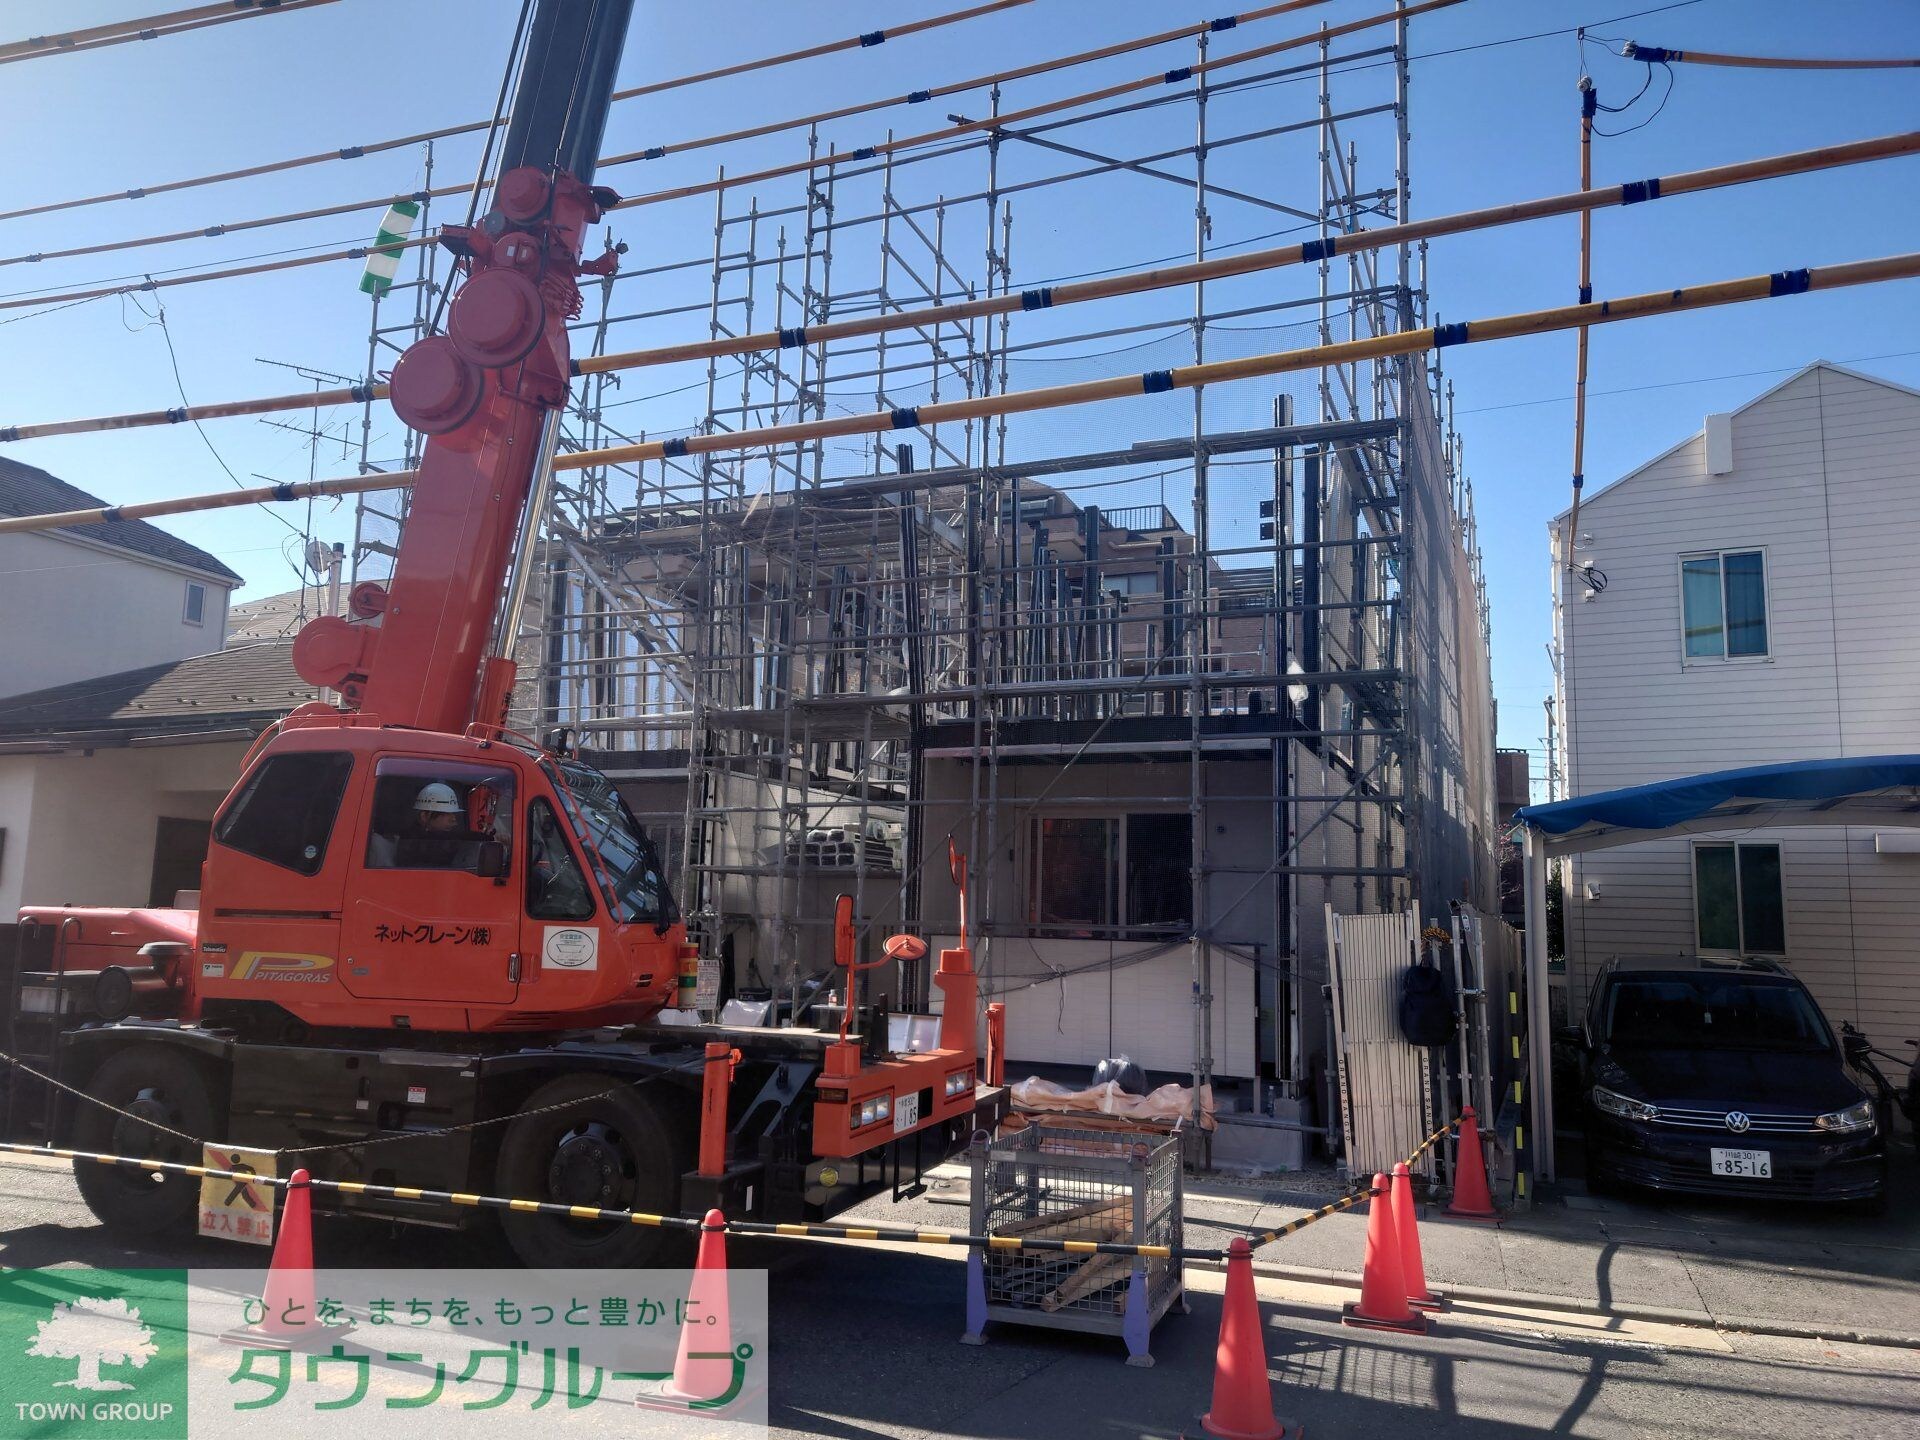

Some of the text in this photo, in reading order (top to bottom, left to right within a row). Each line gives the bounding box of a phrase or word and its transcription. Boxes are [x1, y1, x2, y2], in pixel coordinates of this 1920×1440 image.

[374, 924, 492, 946] ネットクレーン(株)
[254, 971, 331, 983] PITAGORAS
[1343, 1099, 1351, 1141] SANGYO
[1742, 1152, 1756, 1160] 301
[1725, 1160, 1768, 1176] 85-16
[202, 1210, 270, 1239] 立入禁止
